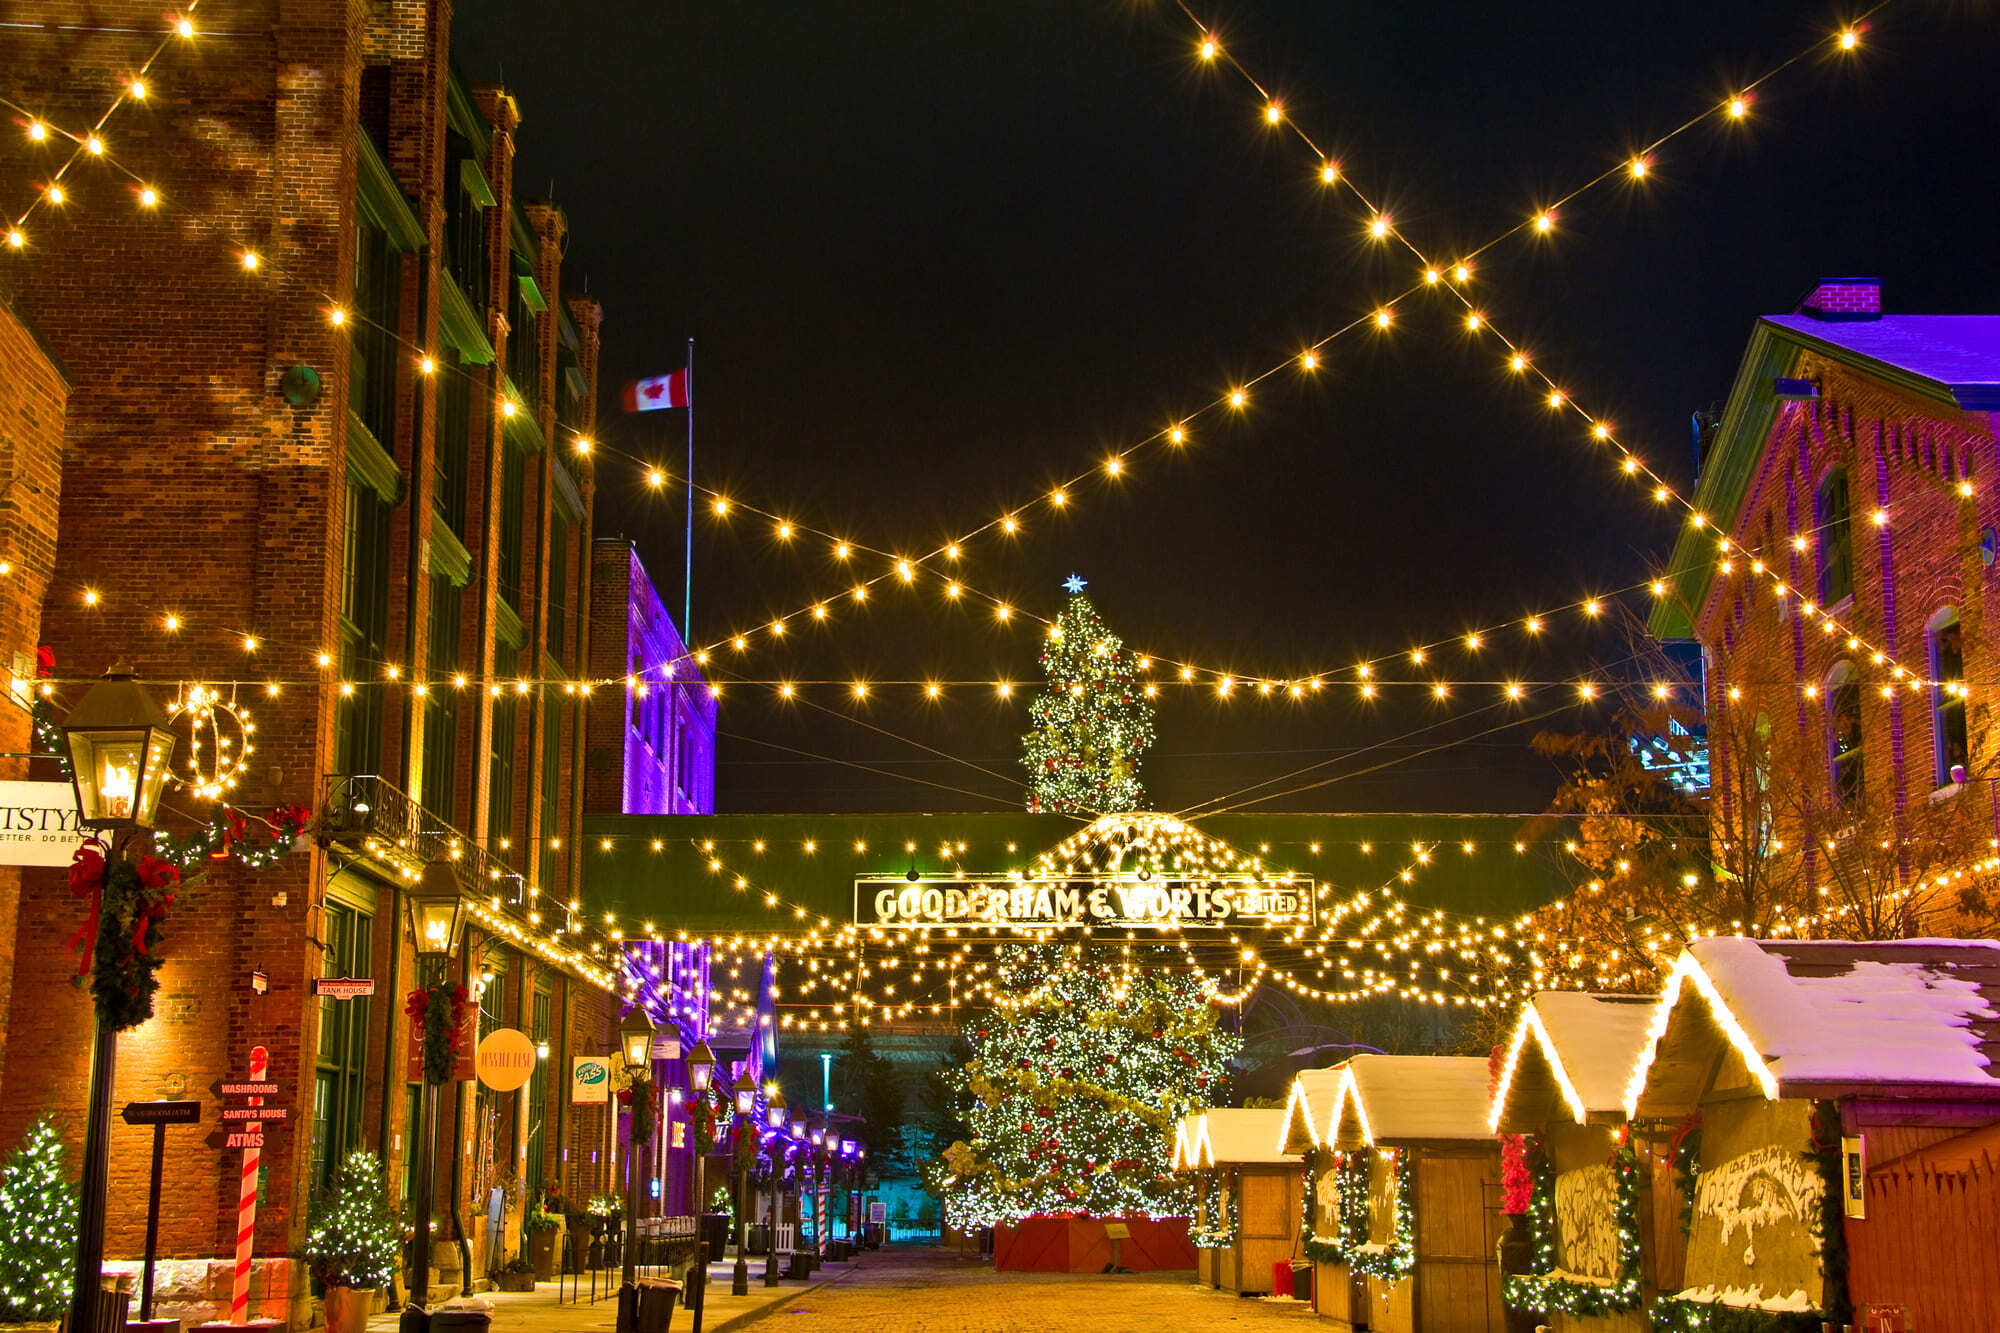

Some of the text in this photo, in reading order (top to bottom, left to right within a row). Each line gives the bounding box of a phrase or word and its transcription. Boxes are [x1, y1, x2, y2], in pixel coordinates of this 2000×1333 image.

[874, 888, 1080, 919] GOODERHAM
[1090, 888, 1117, 918] &
[1119, 888, 1232, 919] WORTS
[578, 1065, 602, 1084] FASS
[221, 1084, 279, 1094] WASHROOMS
[223, 1108, 287, 1119] SANTA'S HOUSE
[226, 1133, 264, 1148] ATMS
